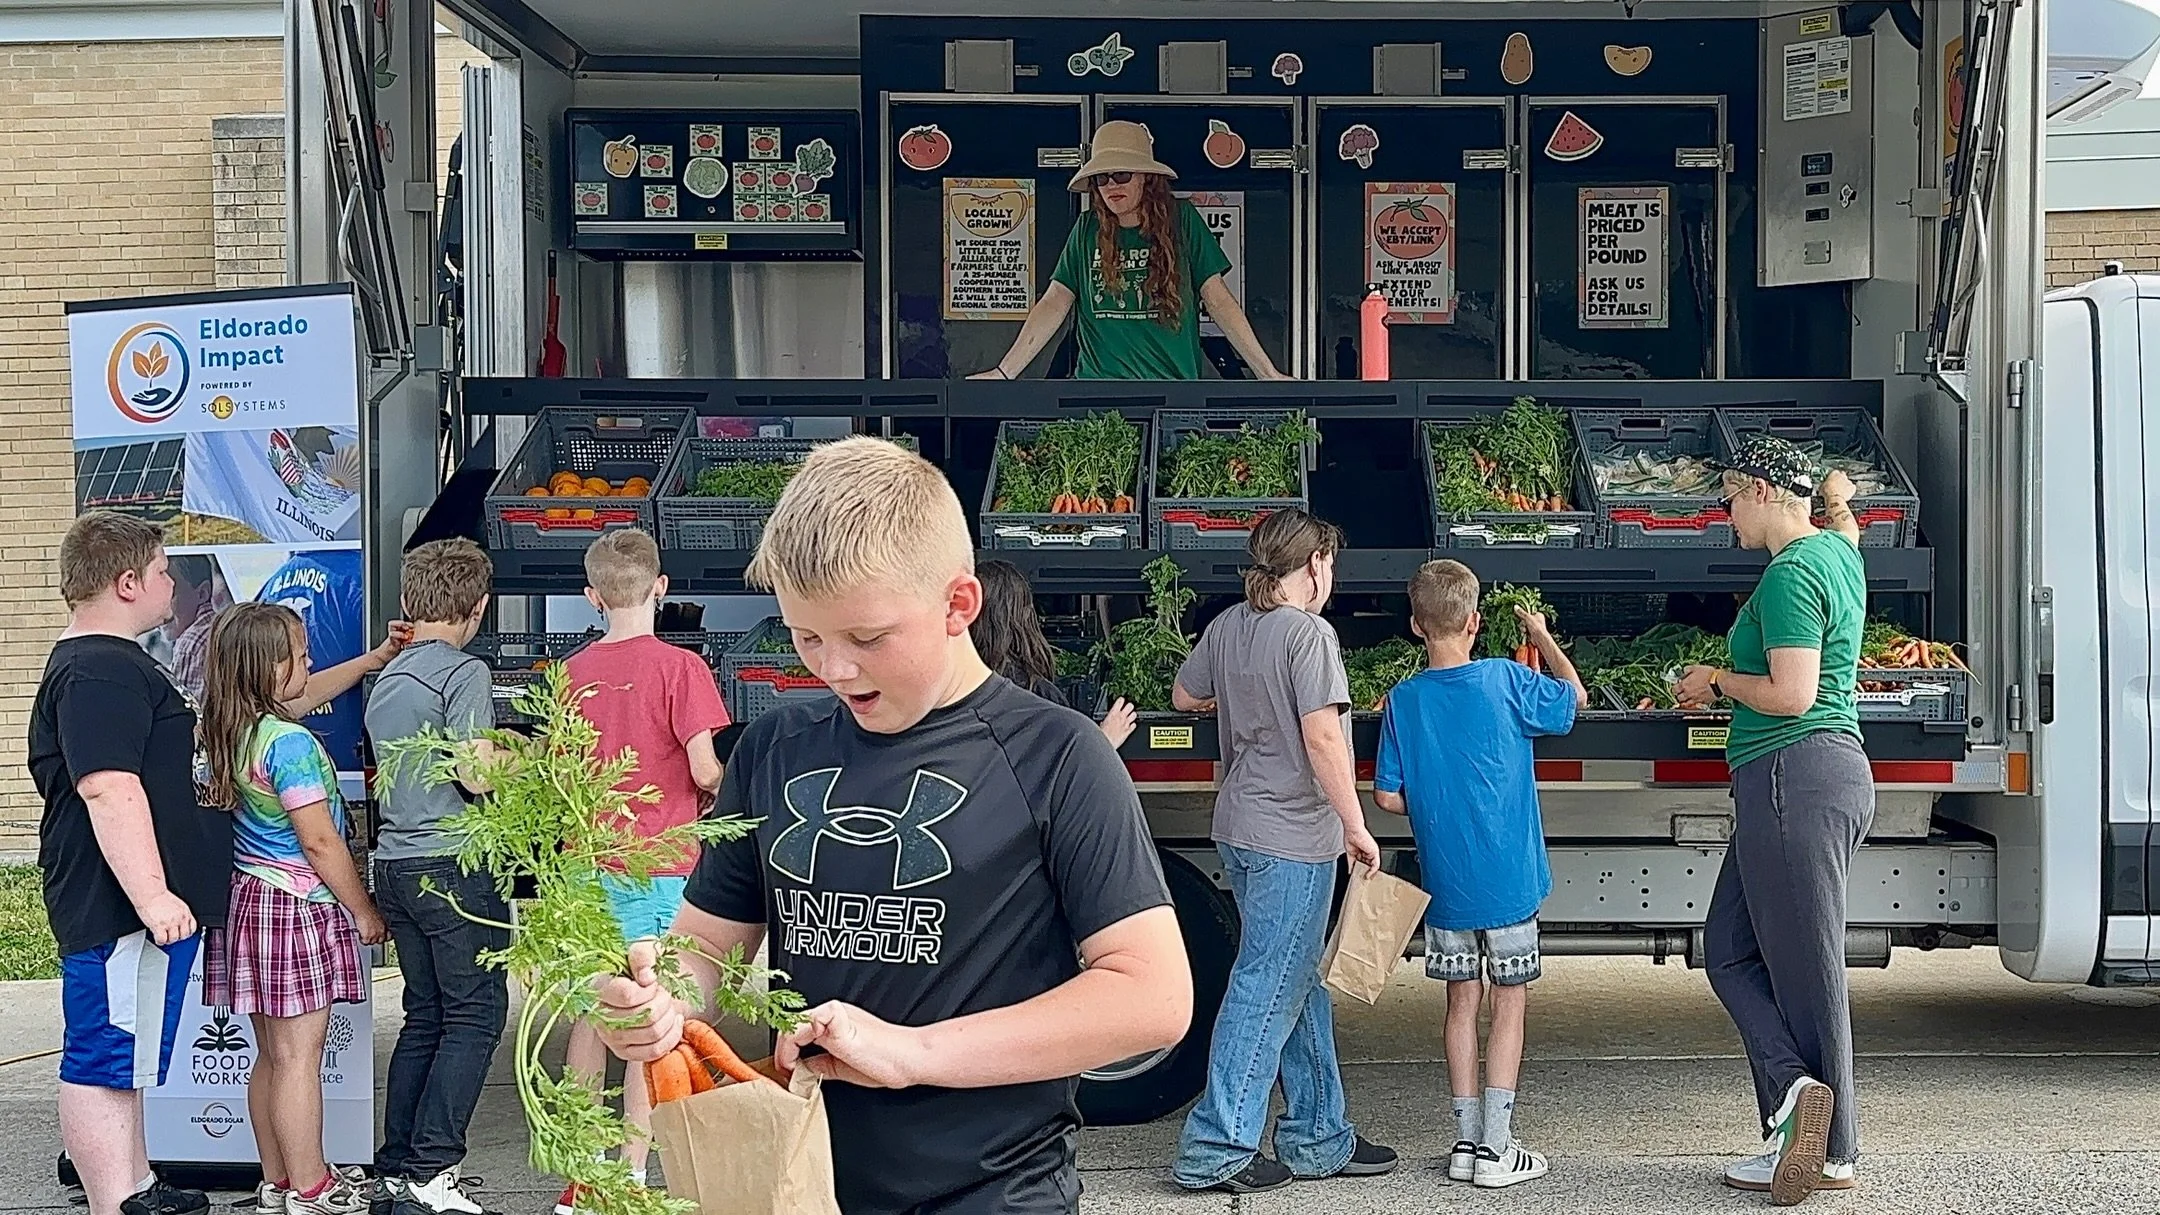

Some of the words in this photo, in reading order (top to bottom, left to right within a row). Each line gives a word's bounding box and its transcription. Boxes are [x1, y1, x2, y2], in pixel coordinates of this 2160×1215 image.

[965, 209, 1014, 218] LOCALLY
[1588, 203, 1637, 217] MEAT
[1645, 204, 1660, 217] IS
[967, 219, 1012, 229] GROWN!
[1208, 214, 1232, 228] US
[1588, 219, 1645, 233] PRICED
[1380, 225, 1400, 235] WE
[1402, 226, 1441, 235] ACCEPT
[1386, 235, 1435, 245] EBT/LINK
[1588, 234, 1618, 248] PER
[1588, 250, 1647, 264] POUND
[1383, 280, 1431, 288] EXTEND
[1588, 278, 1618, 290] ASK
[1626, 278, 1645, 289] US
[1391, 289, 1424, 297] YOUR
[1588, 292, 1618, 302] FOR
[1388, 298, 1440, 307] ENEFITS!
[1588, 303, 1652, 315] DETAILS!
[200, 314, 308, 339] Eldorado
[200, 345, 284, 371] Impact
[275, 497, 335, 541] ILLINOIS
[270, 567, 327, 595] ILLINOIS
[775, 888, 946, 935] UNDER
[192, 1055, 250, 1070] FOOD
[192, 1072, 250, 1085] WORKS
